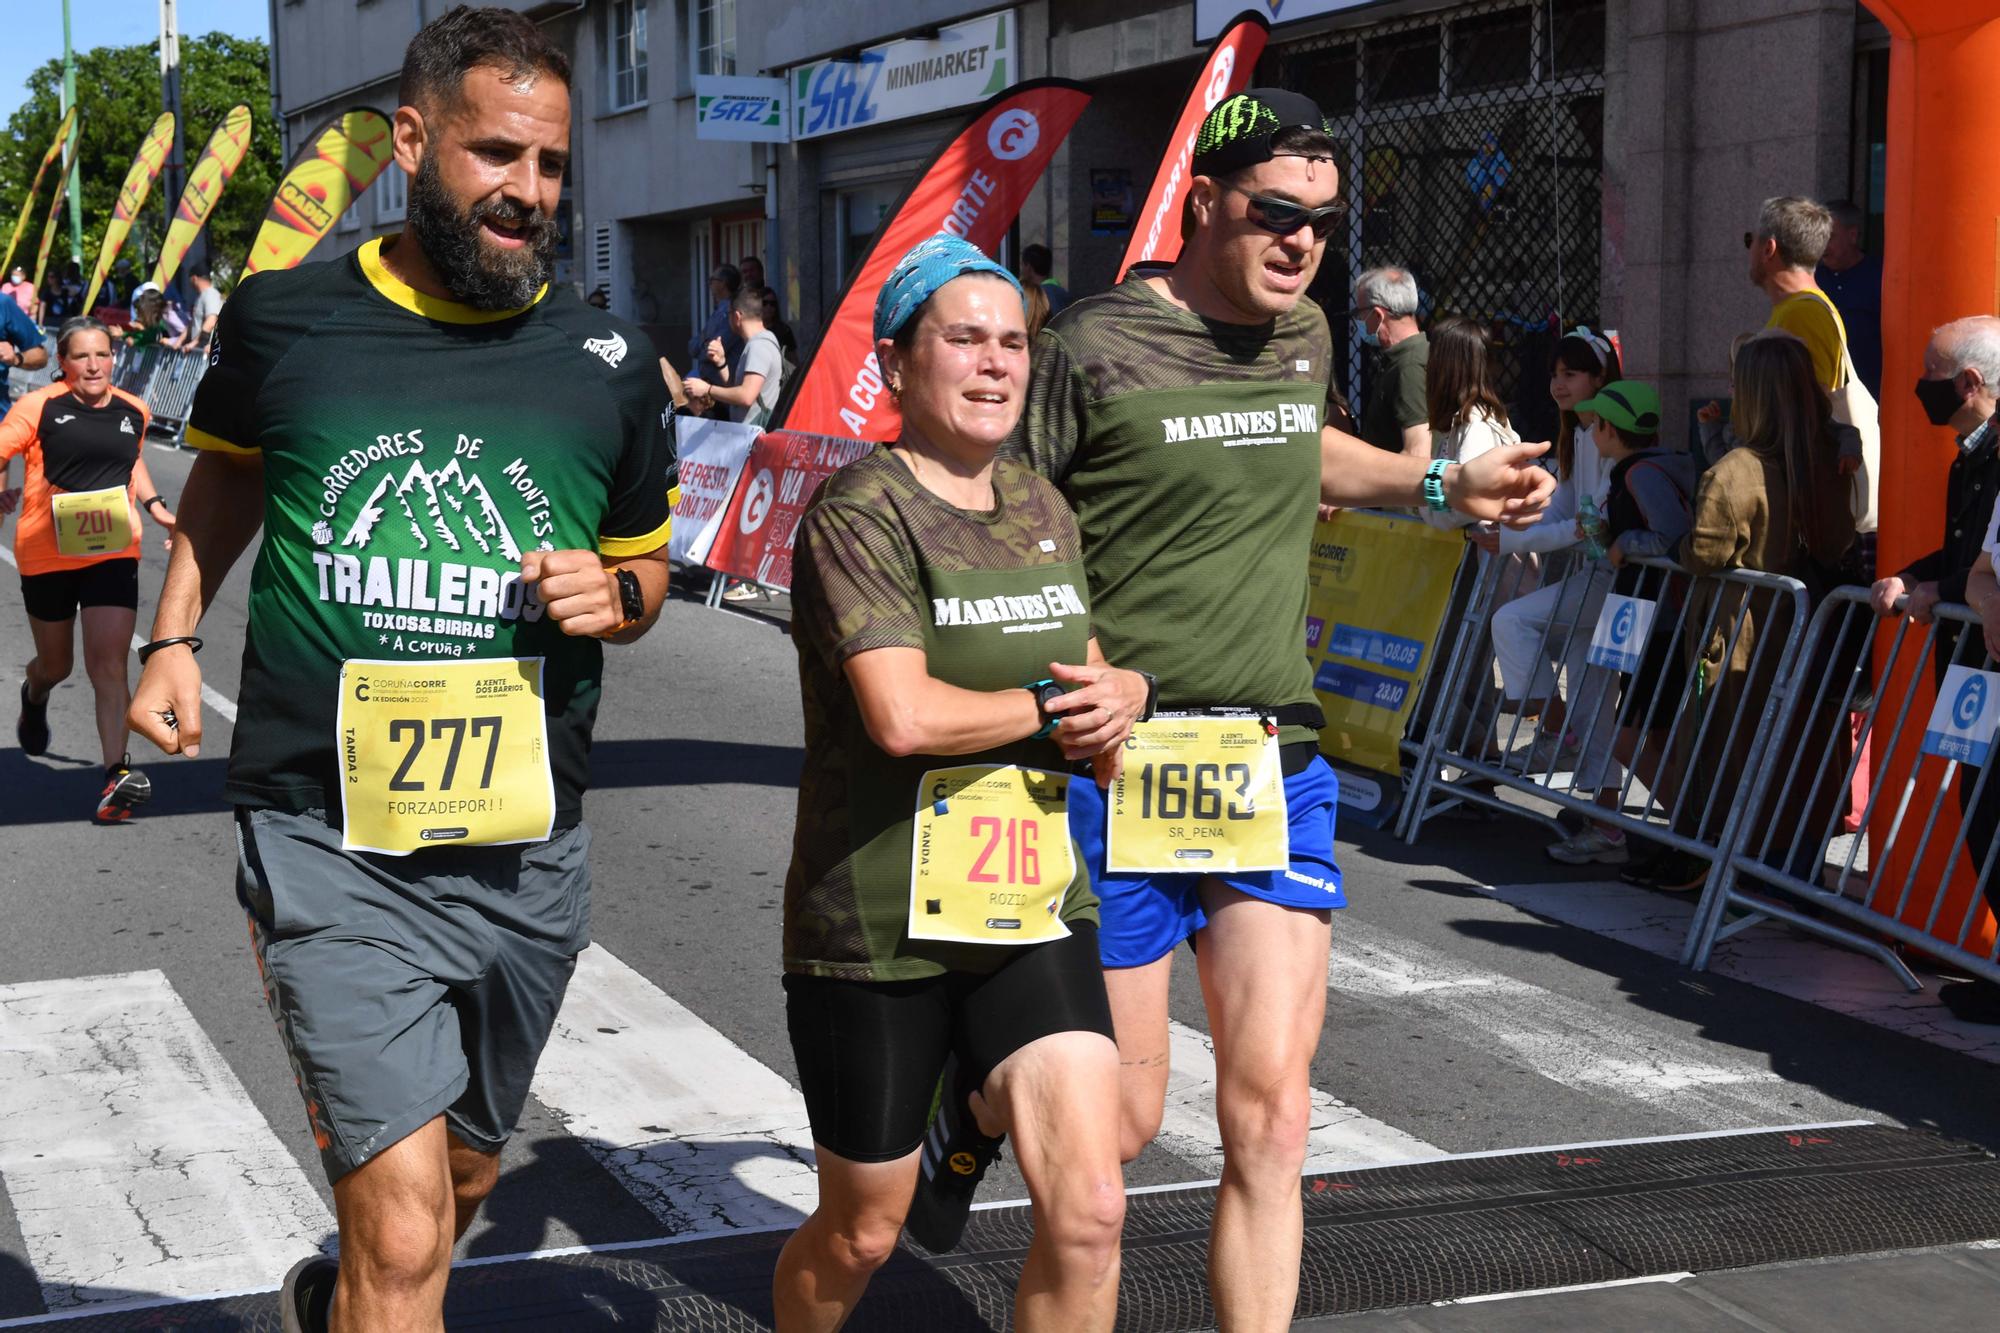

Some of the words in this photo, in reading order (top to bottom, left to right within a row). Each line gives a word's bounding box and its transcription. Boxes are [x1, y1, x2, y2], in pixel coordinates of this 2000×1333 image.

[808, 51, 885, 134] SAZ
[886, 45, 990, 92] MINIMARKET
[710, 101, 768, 122] SAZ
[281, 185, 331, 228] GADIS
[1161, 410, 1277, 443] MARINES
[320, 429, 424, 518] CORREDORES
[454, 434, 483, 459] DE
[503, 457, 554, 537] MONTES
[75, 508, 113, 537] 201
[933, 594, 1049, 626] MARINES
[363, 611, 496, 640] TOXOS&BIRRAS
[393, 636, 404, 652] A
[1385, 642, 1417, 664] 08.05
[475, 686, 492, 694] DOS
[493, 685, 524, 694] BARRIOS
[483, 679, 506, 687] XENTE
[1375, 682, 1403, 703] 23.10
[381, 695, 410, 703] EDICIÓN
[345, 728, 358, 772] TANDA
[389, 716, 503, 792] 277
[1140, 763, 1255, 820] 1663
[388, 798, 503, 815] FORZADEPOR!!
[921, 823, 932, 864] TANDA
[1169, 827, 1225, 840] SR_PENA
[968, 816, 1041, 885] 216
